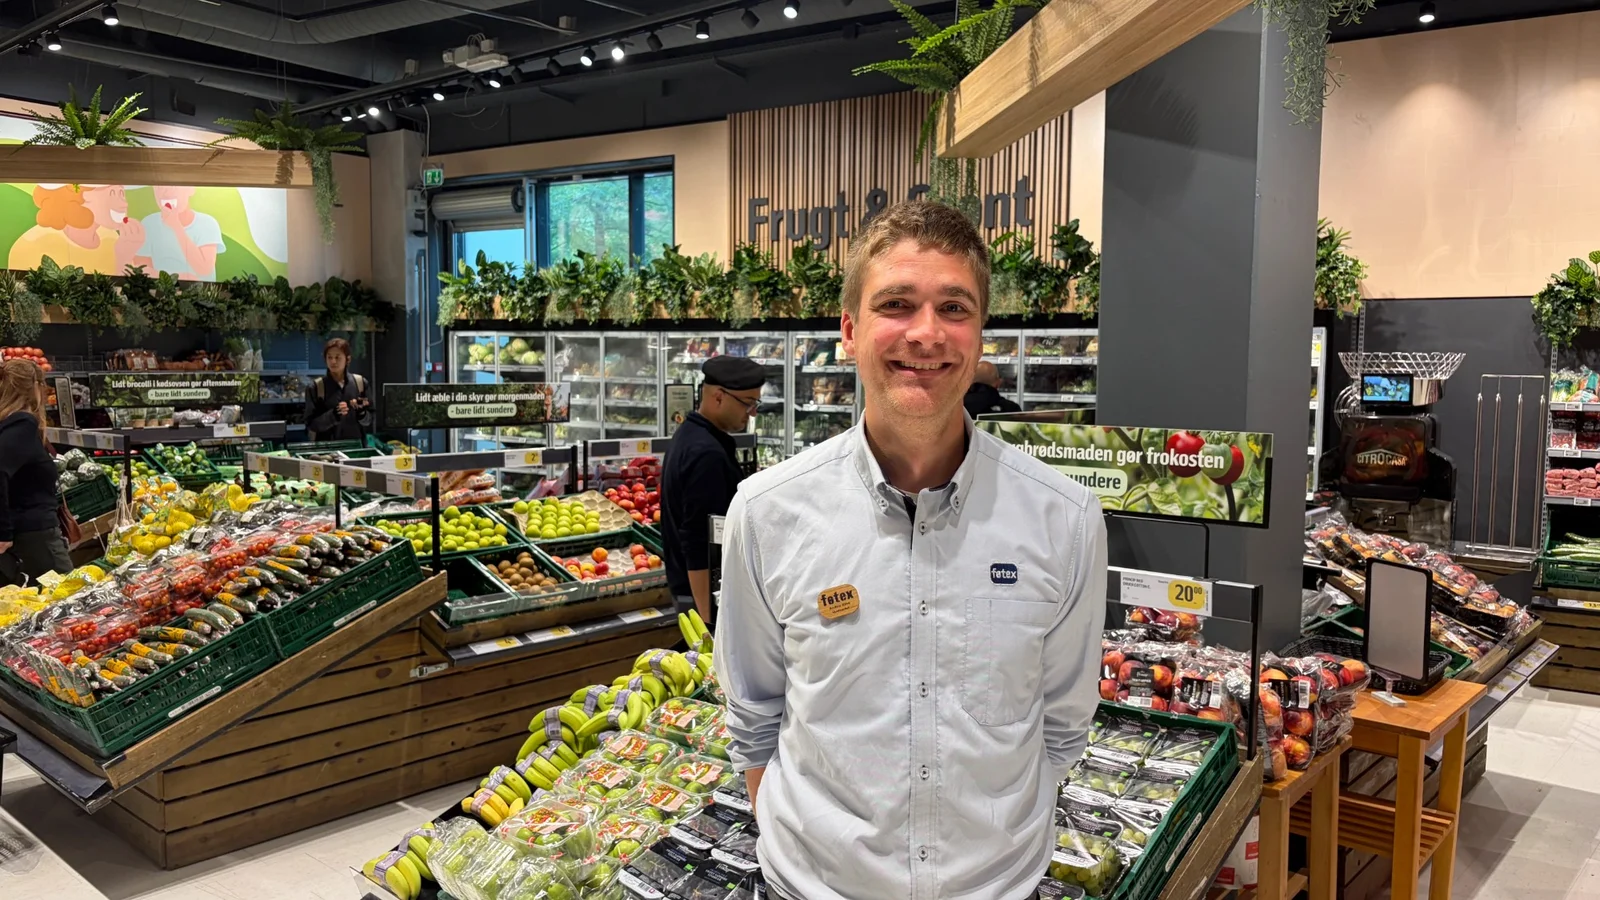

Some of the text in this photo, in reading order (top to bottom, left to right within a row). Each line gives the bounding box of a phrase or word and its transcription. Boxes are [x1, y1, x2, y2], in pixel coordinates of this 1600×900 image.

[748, 190, 849, 250] Frugt
[112, 380, 126, 388] Lidt
[126, 380, 152, 388] brocolli
[202, 379, 242, 387] aftensmaden
[415, 391, 545, 403] Lidt æble i din skyr gør morgenmaden
[455, 405, 472, 415] bare
[473, 405, 486, 415] lidt
[486, 405, 515, 414] sundere
[1116, 449, 1143, 467] gør
[1146, 447, 1225, 469] frokosten
[1065, 471, 1121, 489] ndere
